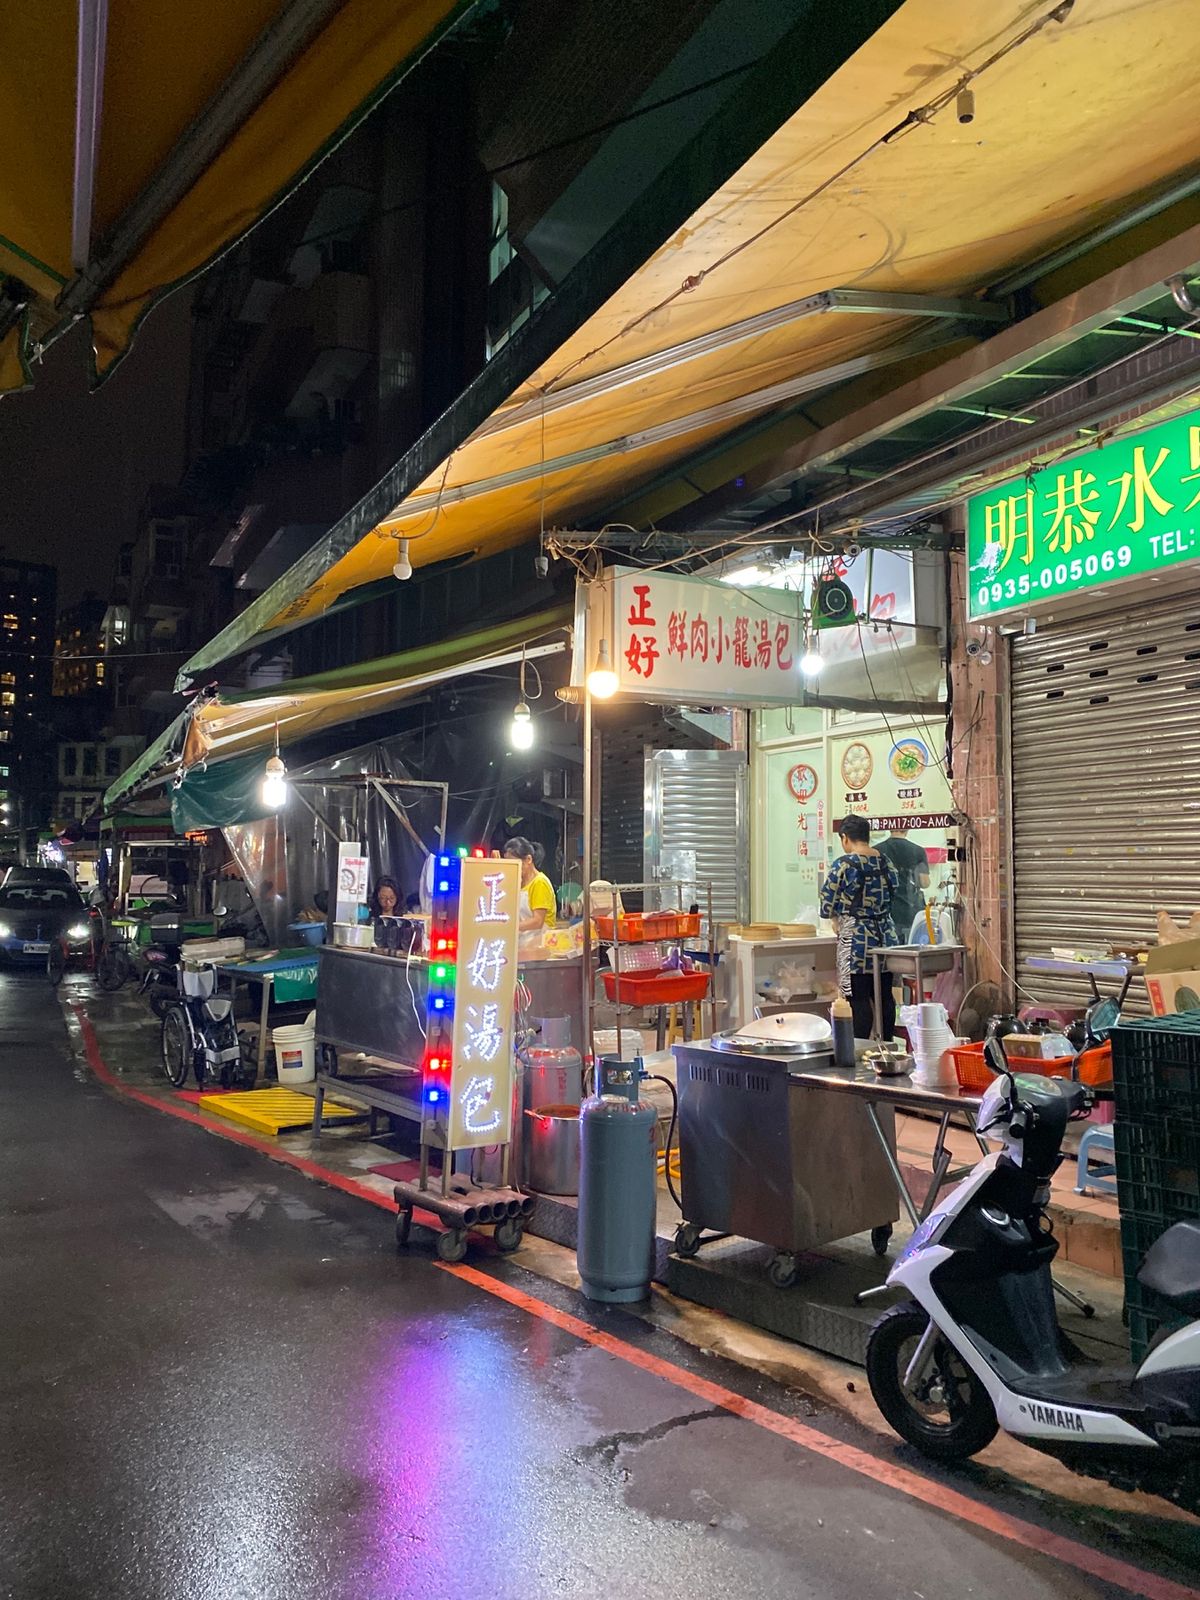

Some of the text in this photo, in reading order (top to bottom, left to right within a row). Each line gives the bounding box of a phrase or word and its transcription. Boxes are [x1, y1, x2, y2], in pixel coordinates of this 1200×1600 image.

[1149, 528, 1195, 559] TEL:
[978, 545, 1132, 605] 0935-005069
[624, 585, 660, 678] 正好
[667, 610, 793, 671] 鮮肉小籠湯包
[459, 872, 510, 1132] 正好湯包
[1027, 1403, 1085, 1433] YAMAHA
